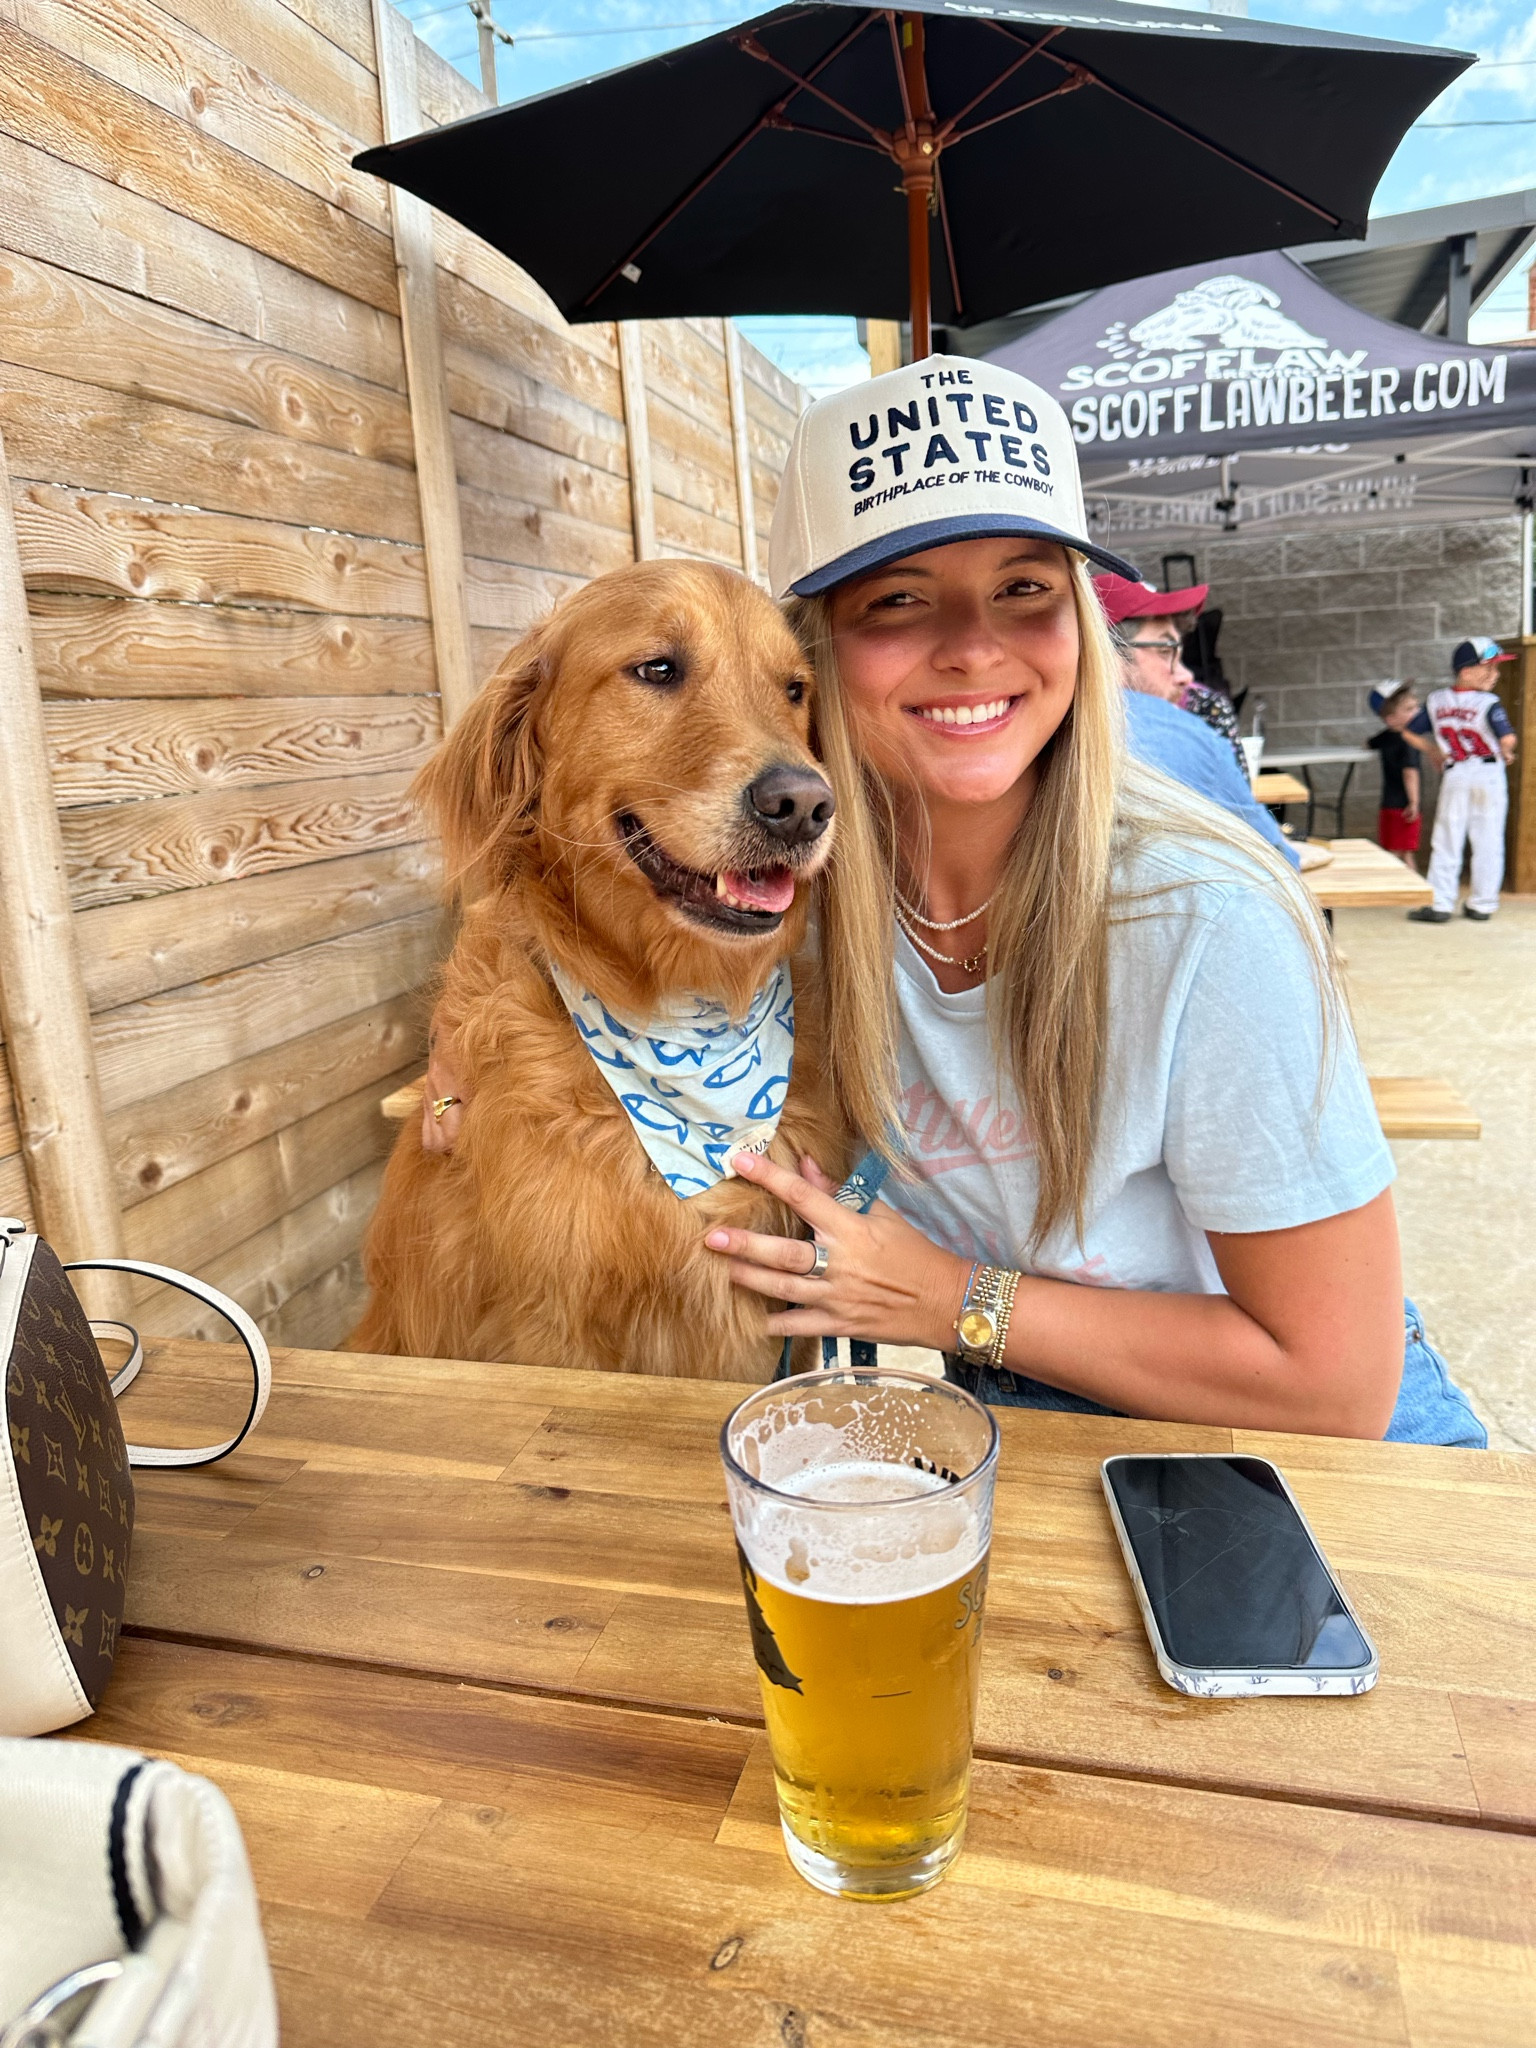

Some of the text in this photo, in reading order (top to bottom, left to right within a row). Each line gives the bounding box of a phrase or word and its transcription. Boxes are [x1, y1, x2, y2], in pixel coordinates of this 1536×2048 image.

[921, 369, 973, 388] THE
[1060, 348, 1369, 391] SCOFFLAW
[850, 393, 1038, 450] UNITED
[1071, 354, 1508, 444] SCOFFLAWBEER.COM
[849, 431, 1051, 493] STATES
[854, 470, 1054, 517] BIRTHPLACE OF THE COWBOY
